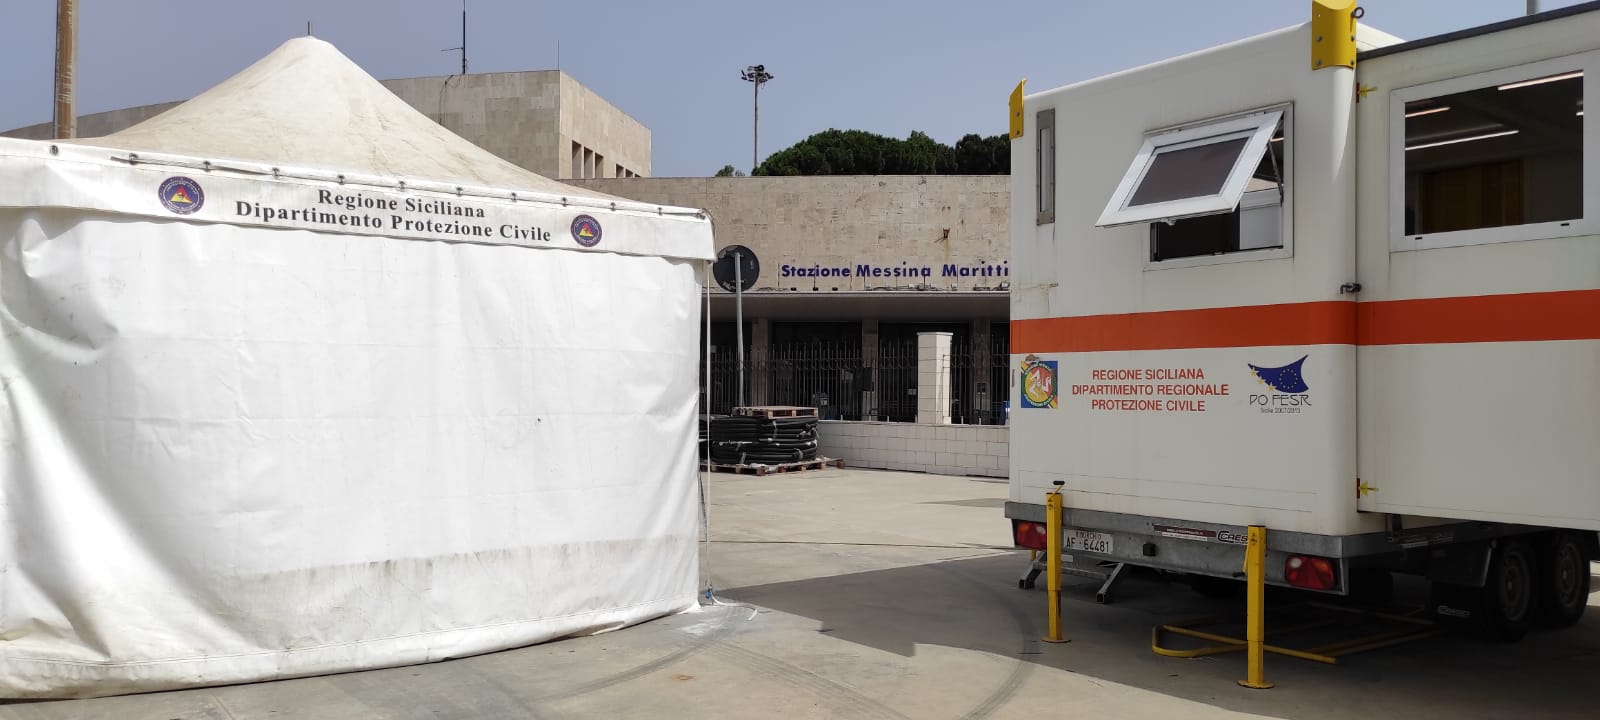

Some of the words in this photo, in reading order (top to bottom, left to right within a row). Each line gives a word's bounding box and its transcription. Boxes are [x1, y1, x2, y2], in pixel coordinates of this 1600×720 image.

[318, 189, 398, 210] Regione
[405, 198, 485, 218] Siciliana
[236, 201, 382, 228] Dipartimento
[392, 215, 493, 237] Protezione
[500, 224, 551, 242] Civile
[781, 264, 851, 277] Stazione
[856, 261, 931, 277] Messina
[942, 260, 1009, 277] Maritti
[1092, 369, 1142, 380] REGIONE
[1145, 368, 1205, 380] SICILIANA
[1072, 384, 1154, 396] DIPARTIMENTO
[1157, 384, 1229, 396] REGIONALE
[1092, 399, 1163, 411] PROTEZIONE
[1166, 400, 1206, 412] CIVILE
[1272, 394, 1312, 407] FESR
[1083, 539, 1109, 553] 64481
